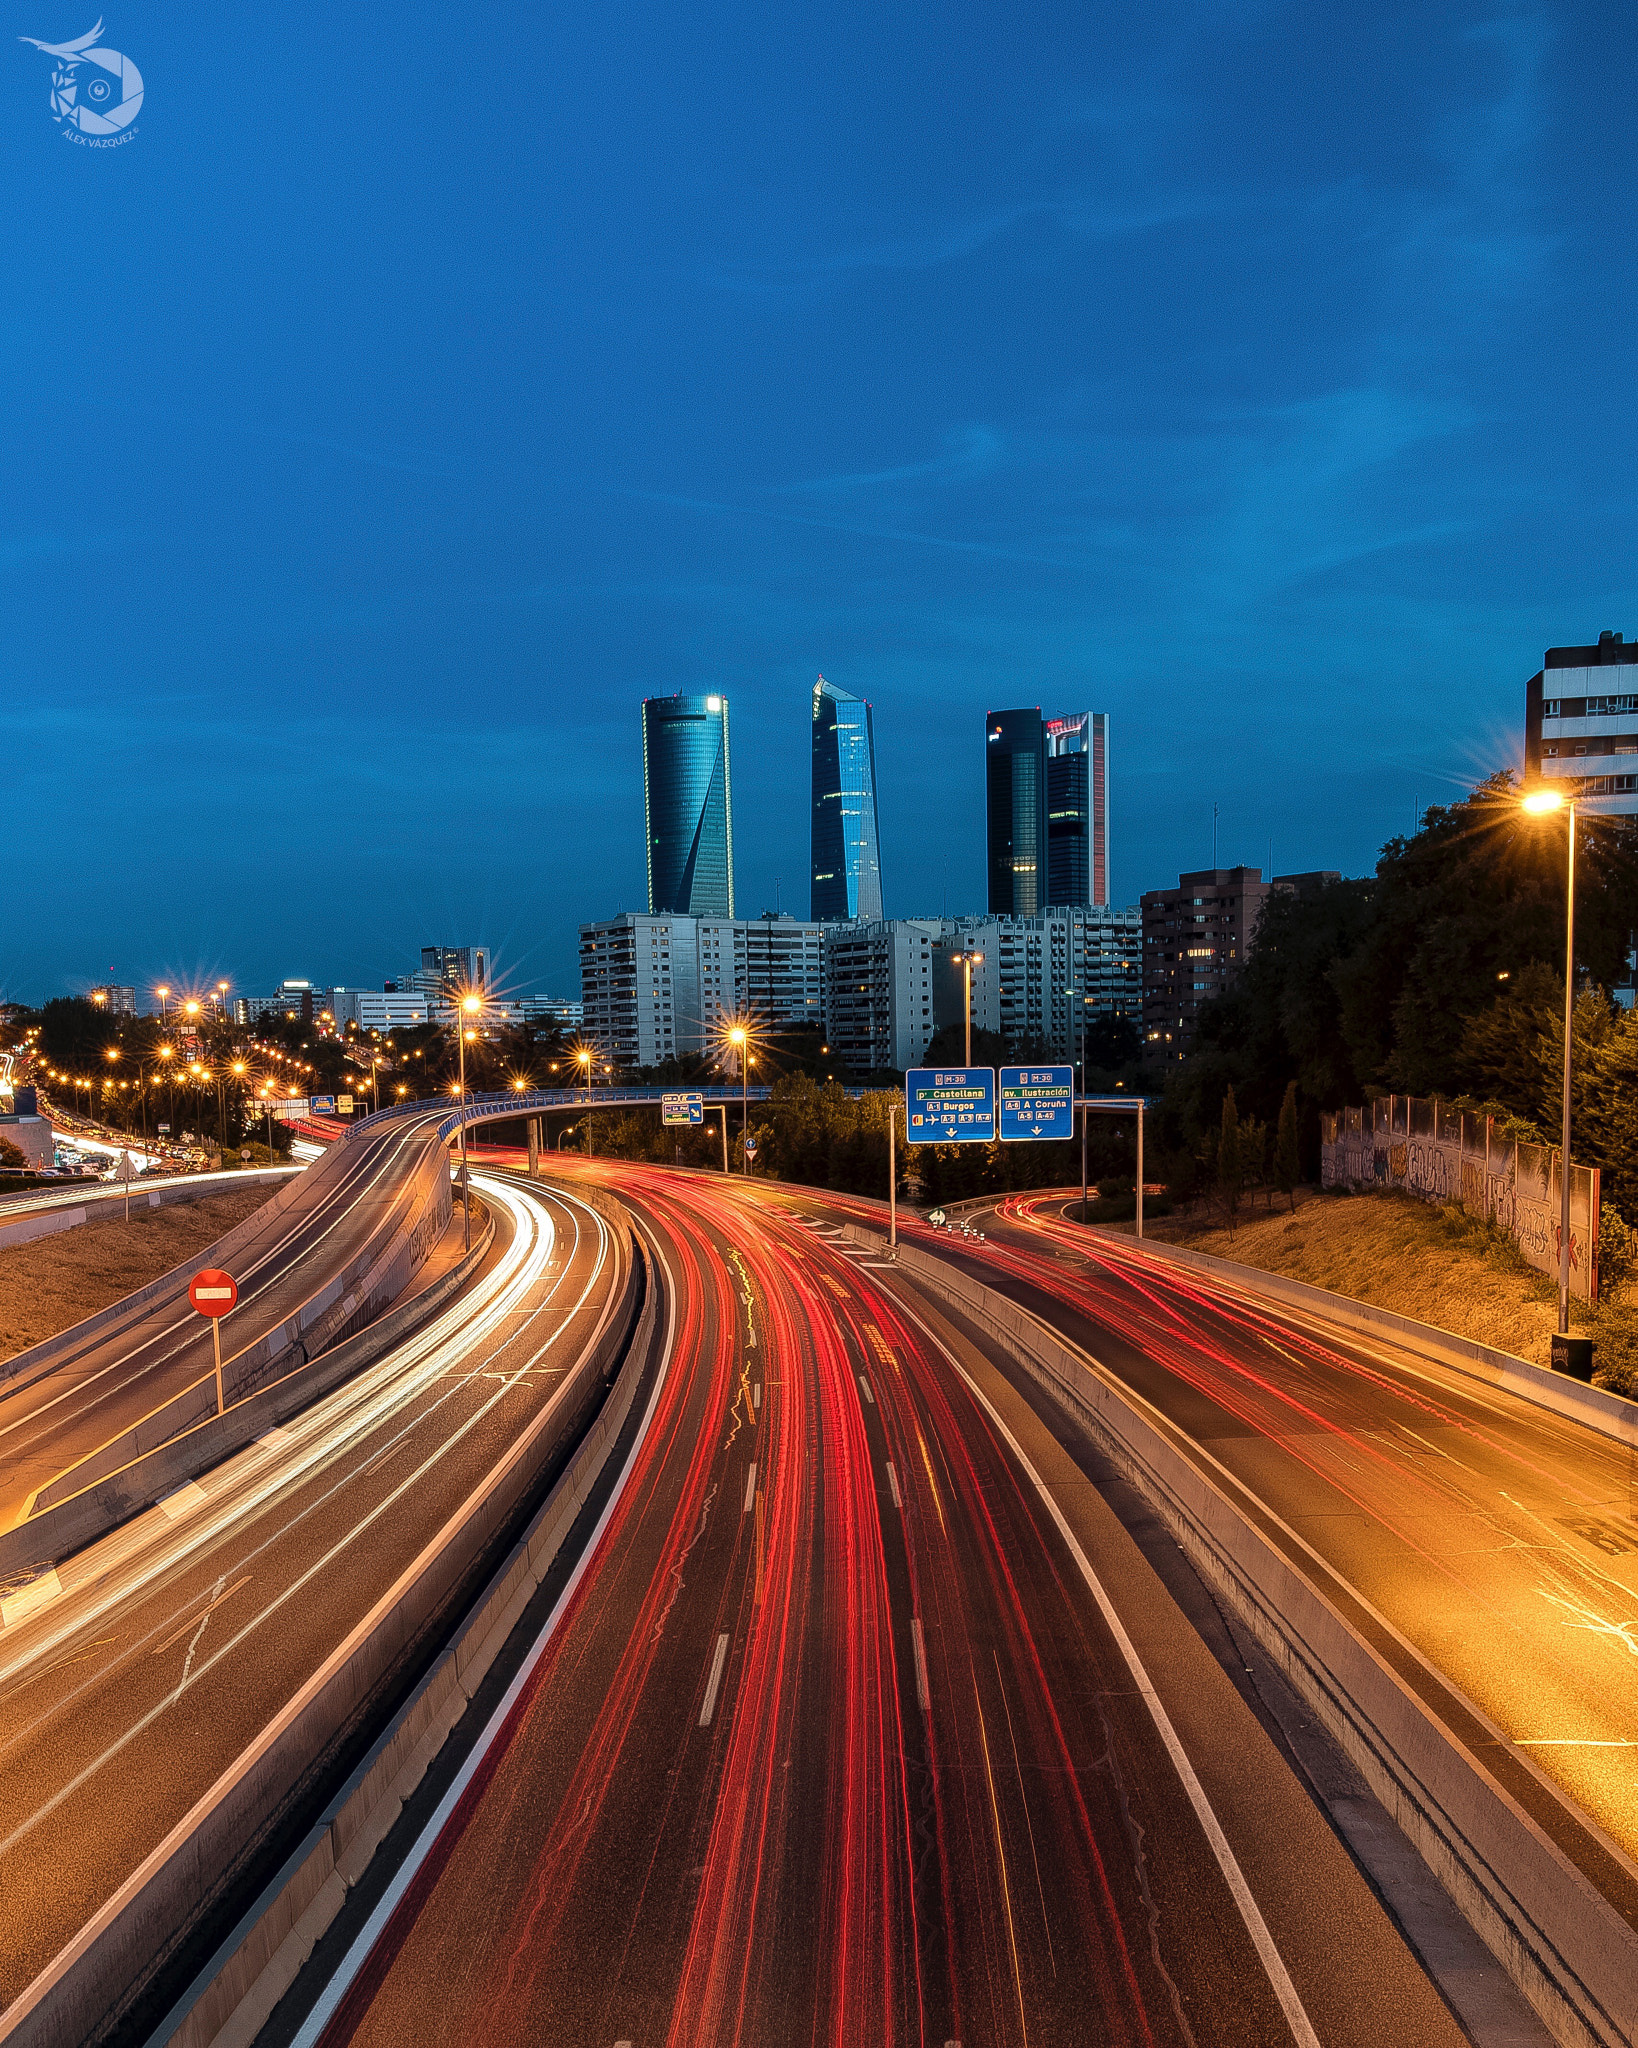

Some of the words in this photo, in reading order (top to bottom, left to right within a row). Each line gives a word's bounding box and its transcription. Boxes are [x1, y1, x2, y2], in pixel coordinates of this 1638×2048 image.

[933, 1090, 983, 1098] Castellana
[1022, 1088, 1068, 1097] Ilustración
[943, 1102, 975, 1112] Burgos
[1023, 1101, 1031, 1109] A
[1035, 1100, 1067, 1108] Coruña
